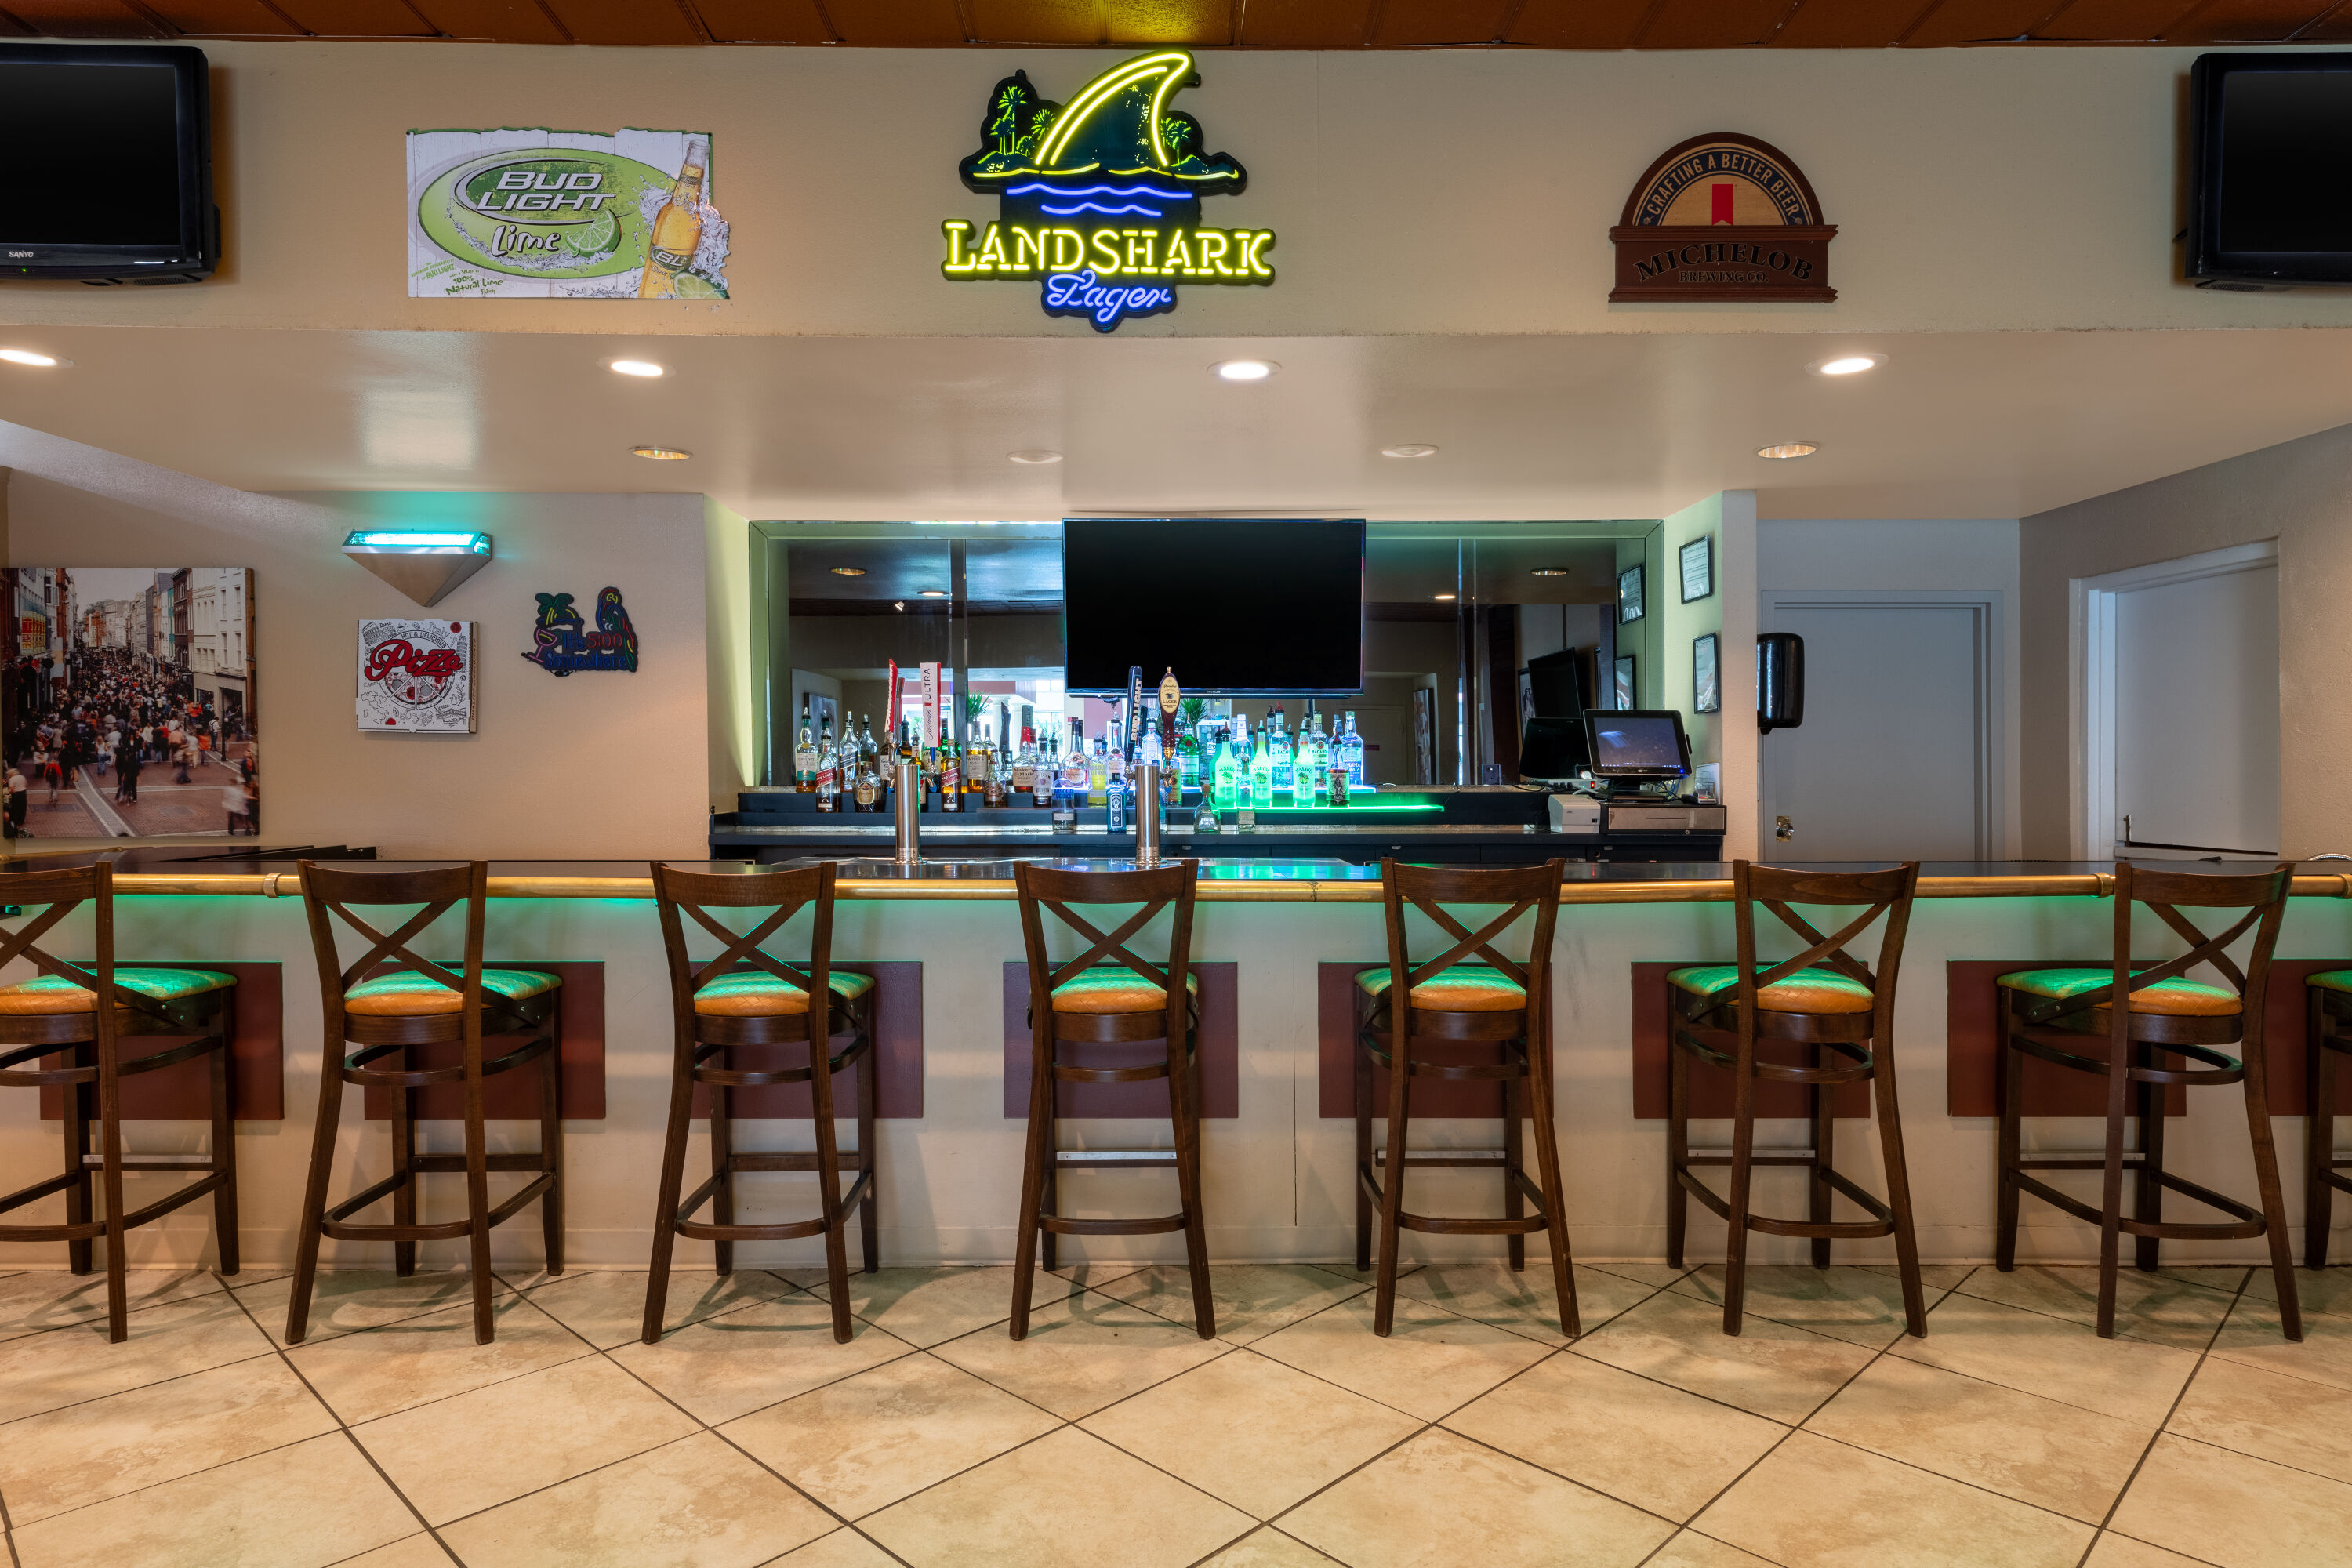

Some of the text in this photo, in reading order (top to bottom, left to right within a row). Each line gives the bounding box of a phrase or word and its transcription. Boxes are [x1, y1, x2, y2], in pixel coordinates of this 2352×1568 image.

[496, 170, 603, 191] BUD
[1647, 153, 1801, 216] CRAFTING A BETTER BEER
[477, 192, 616, 212] LIGHT
[491, 224, 561, 257] Lime
[945, 220, 1272, 276] LANDSHARK
[426, 269, 438, 279] BUD
[437, 263, 455, 275] LIGHT
[1633, 241, 1813, 282] MICHELOB
[453, 275, 474, 284] 100%
[1679, 270, 1769, 283] BREWING CO.
[445, 278, 504, 296] Natural Lime
[1047, 270, 1171, 322] Lager
[420, 632, 447, 648] DELICIOUS
[427, 622, 451, 639] Italy
[564, 633, 584, 649] It's
[364, 639, 463, 681] Pizza
[545, 652, 626, 667] Somewhere
[1133, 677, 1142, 714] LIGHT
[1131, 715, 1139, 742] BUD
